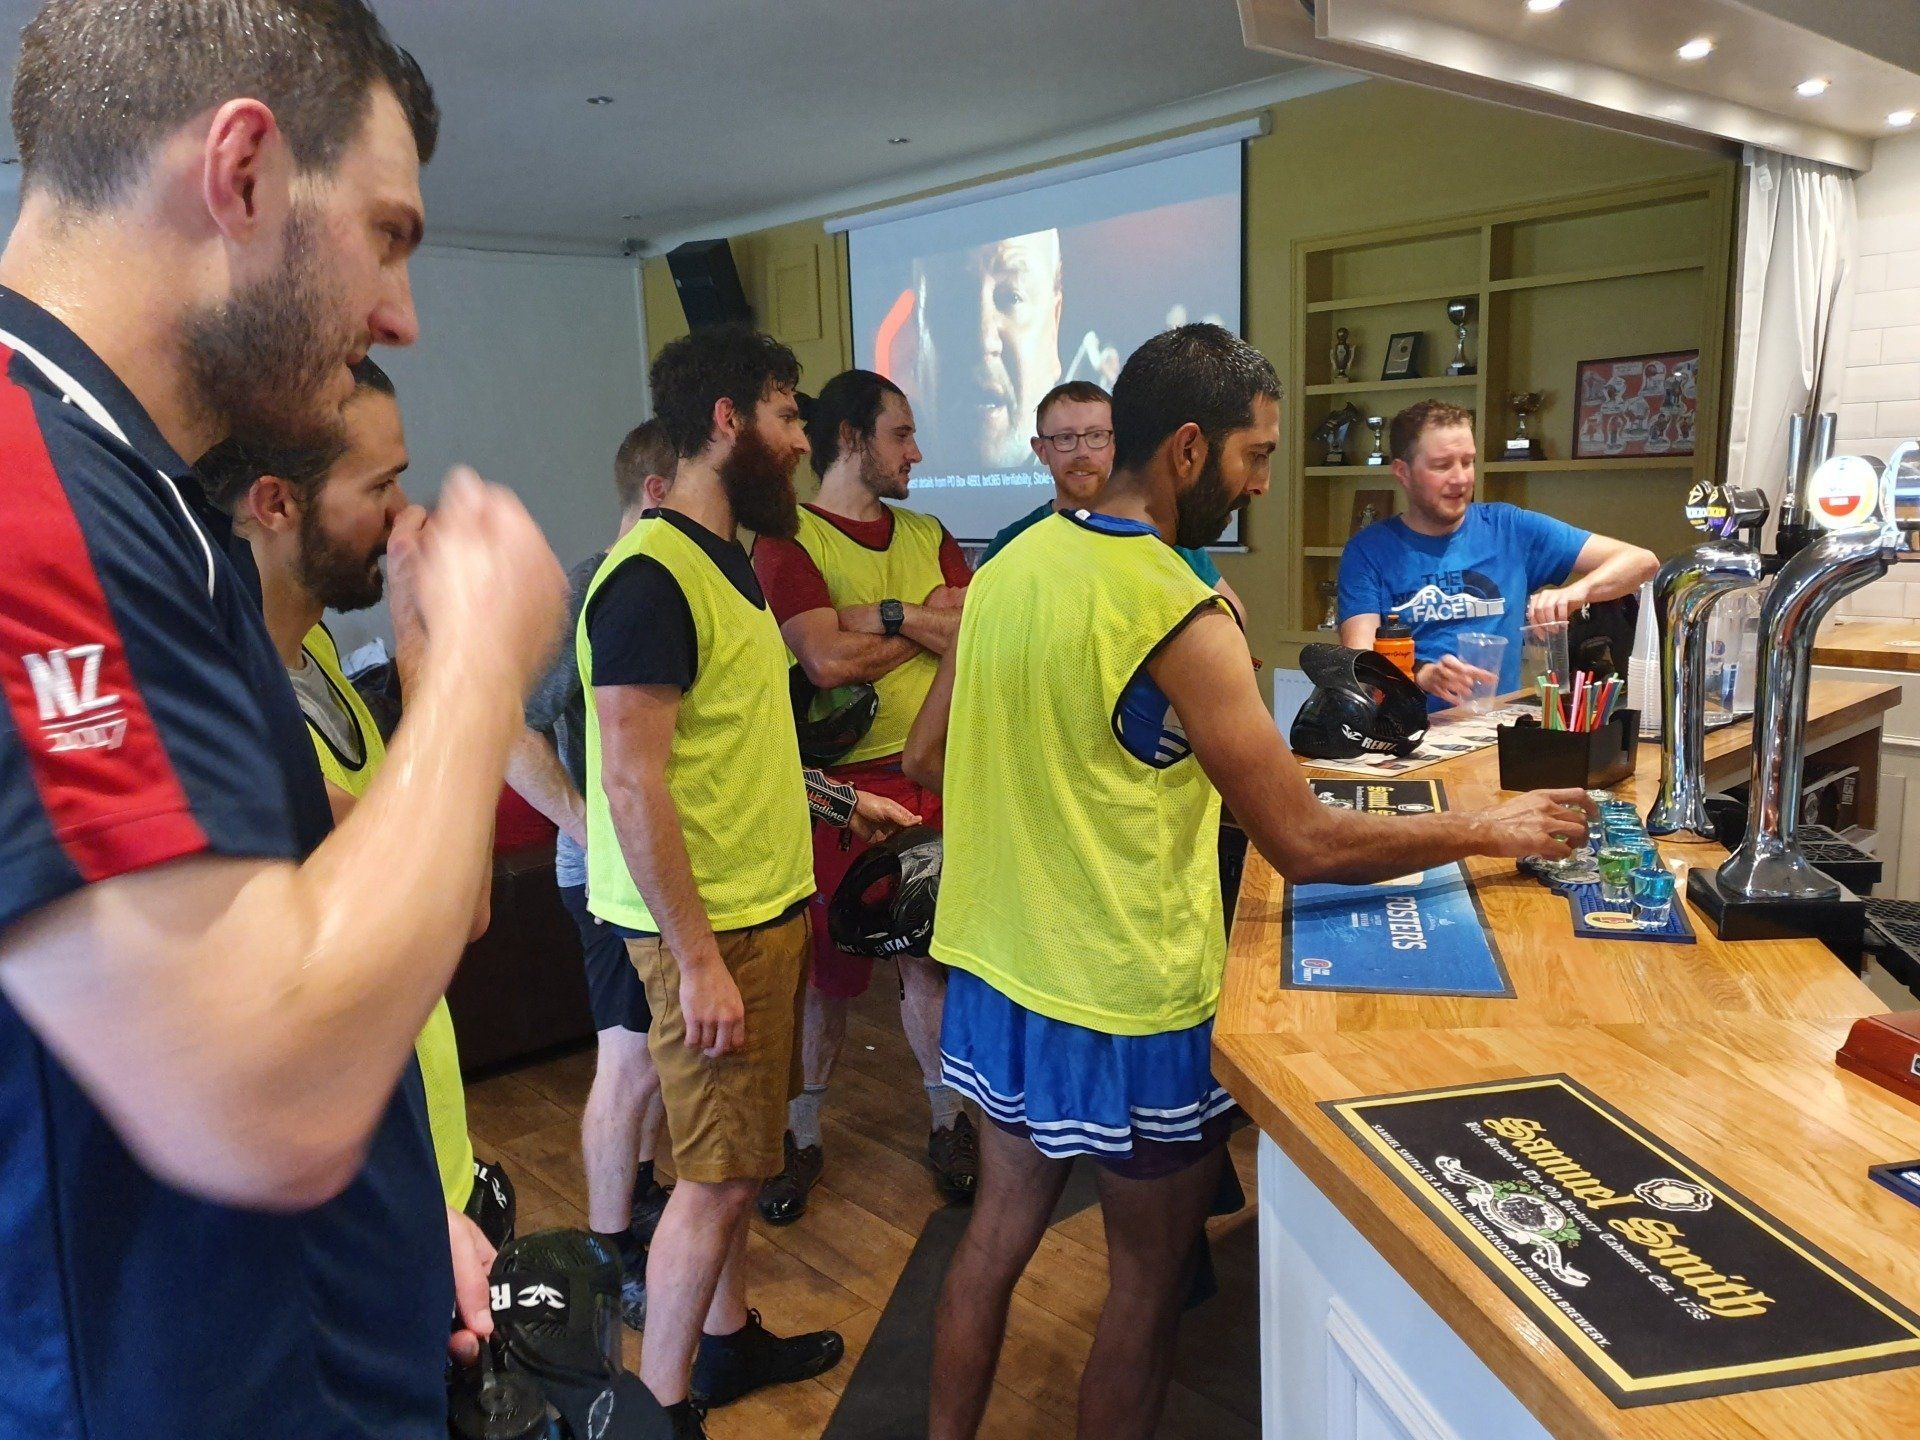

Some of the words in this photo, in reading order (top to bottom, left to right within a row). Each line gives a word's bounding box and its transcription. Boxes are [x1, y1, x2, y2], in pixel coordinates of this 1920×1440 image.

[1412, 602, 1466, 623] FACE
[1420, 570, 1463, 594] THE
[22, 643, 120, 720] NZ
[1385, 895, 1427, 950] FOSTER'S
[1371, 1124, 1402, 1149] SAMUEL
[1397, 1148, 1430, 1175] SMITH'S
[1423, 1172, 1437, 1182] IS
[1430, 1181, 1443, 1189] A
[1464, 1212, 1527, 1268] INDEPENDENT
[1521, 1266, 1563, 1301] BRITISH
[1483, 1117, 1643, 1209] Samuel
[1607, 1217, 1776, 1318] Smith
[1511, 1161, 1527, 1170] at
[1522, 1169, 1543, 1184] The
[1540, 1184, 1562, 1199] Old
[1557, 1199, 1602, 1233] Brewery
[1599, 1232, 1652, 1274] Tadcaster
[1674, 1296, 1711, 1321] 1758
